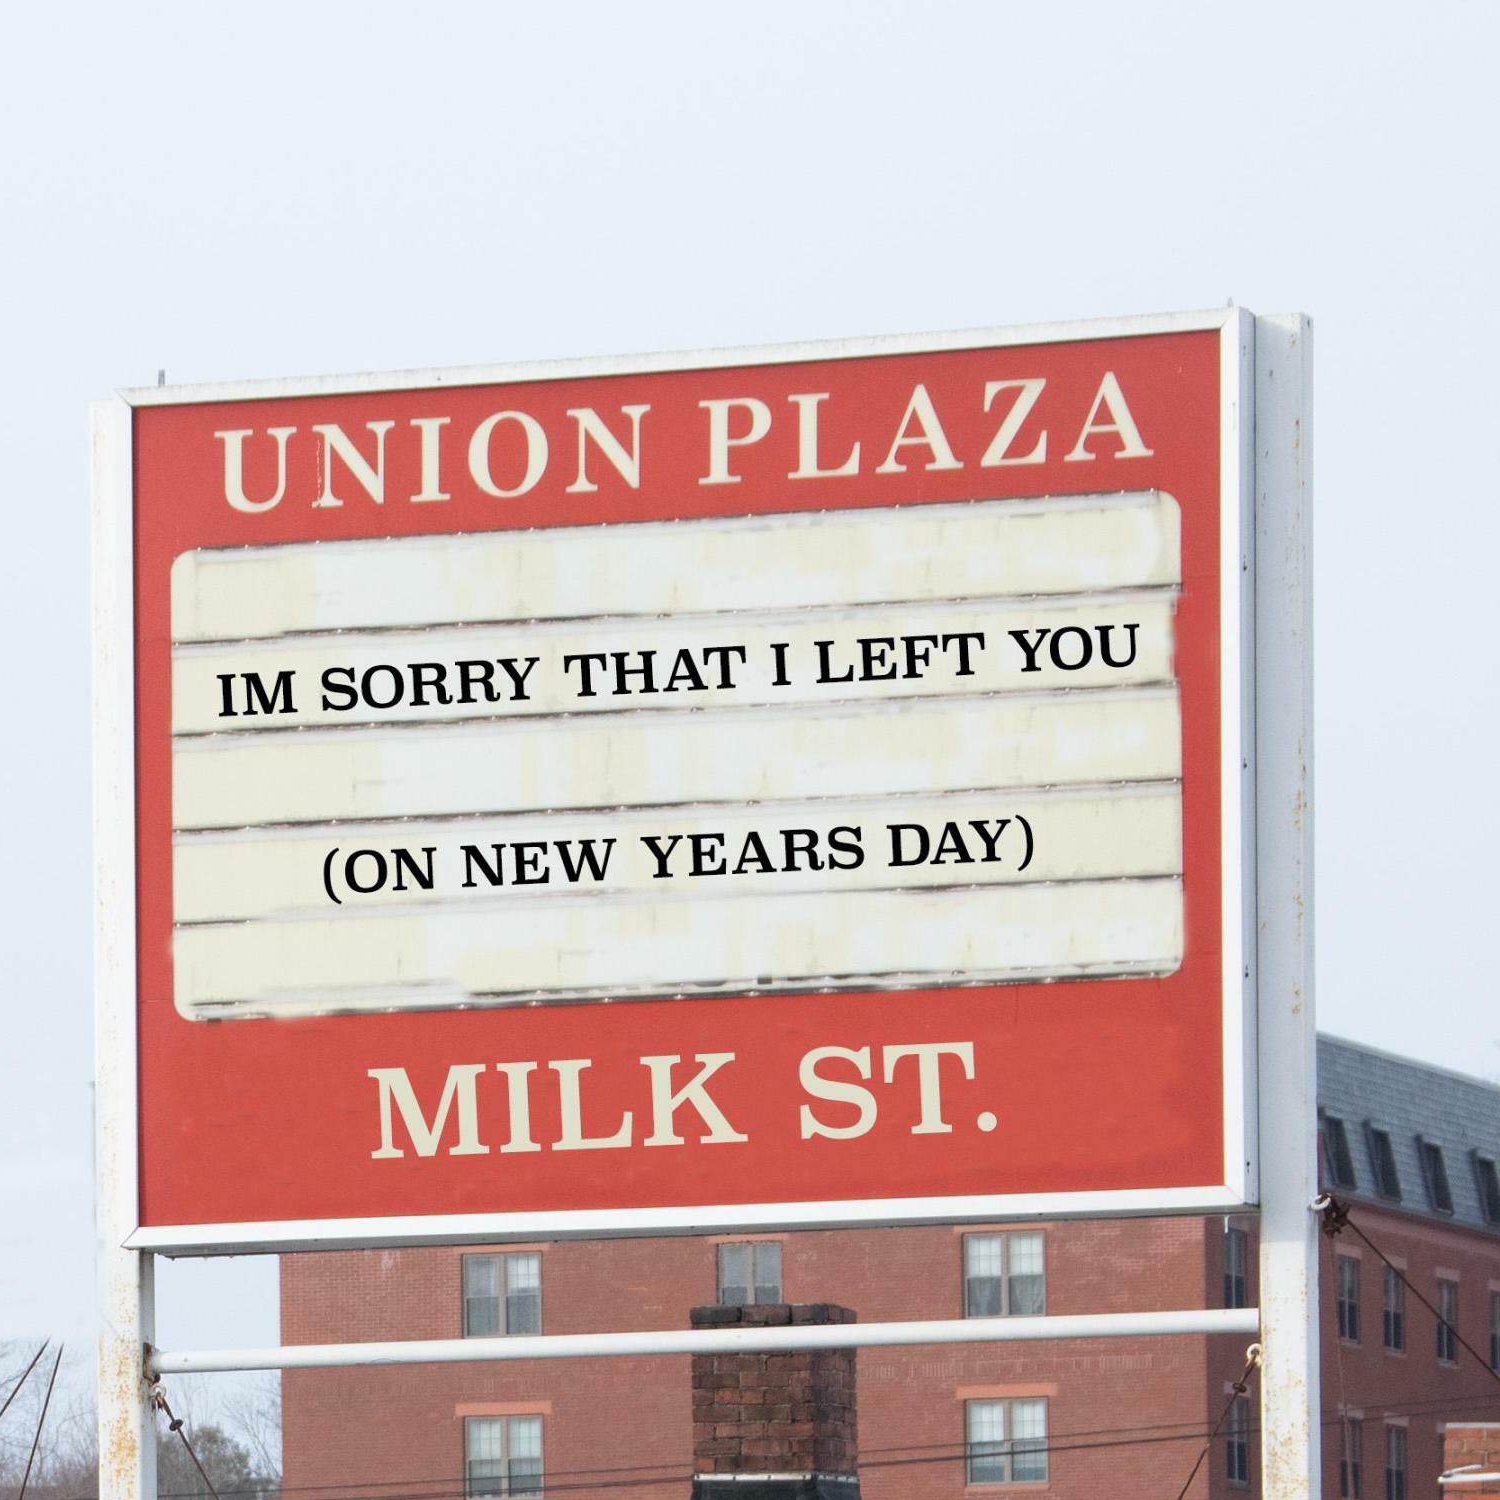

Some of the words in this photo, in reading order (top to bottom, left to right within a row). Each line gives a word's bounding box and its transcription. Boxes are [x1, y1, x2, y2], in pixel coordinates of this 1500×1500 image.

[213, 404, 651, 514] UNION
[698, 371, 1154, 485] PLAZA
[216, 670, 298, 717] IM
[321, 656, 540, 711] SORRY
[563, 645, 747, 697] THAT
[769, 643, 792, 686] I
[813, 632, 985, 684] LEFT
[1007, 623, 1140, 673] YOU
[323, 846, 437, 905] (ON
[460, 838, 617, 888] NEW
[640, 826, 865, 879] YEARS
[886, 814, 1034, 872] DAY)
[367, 1052, 749, 1159] MILK
[799, 1041, 998, 1140] ST.
